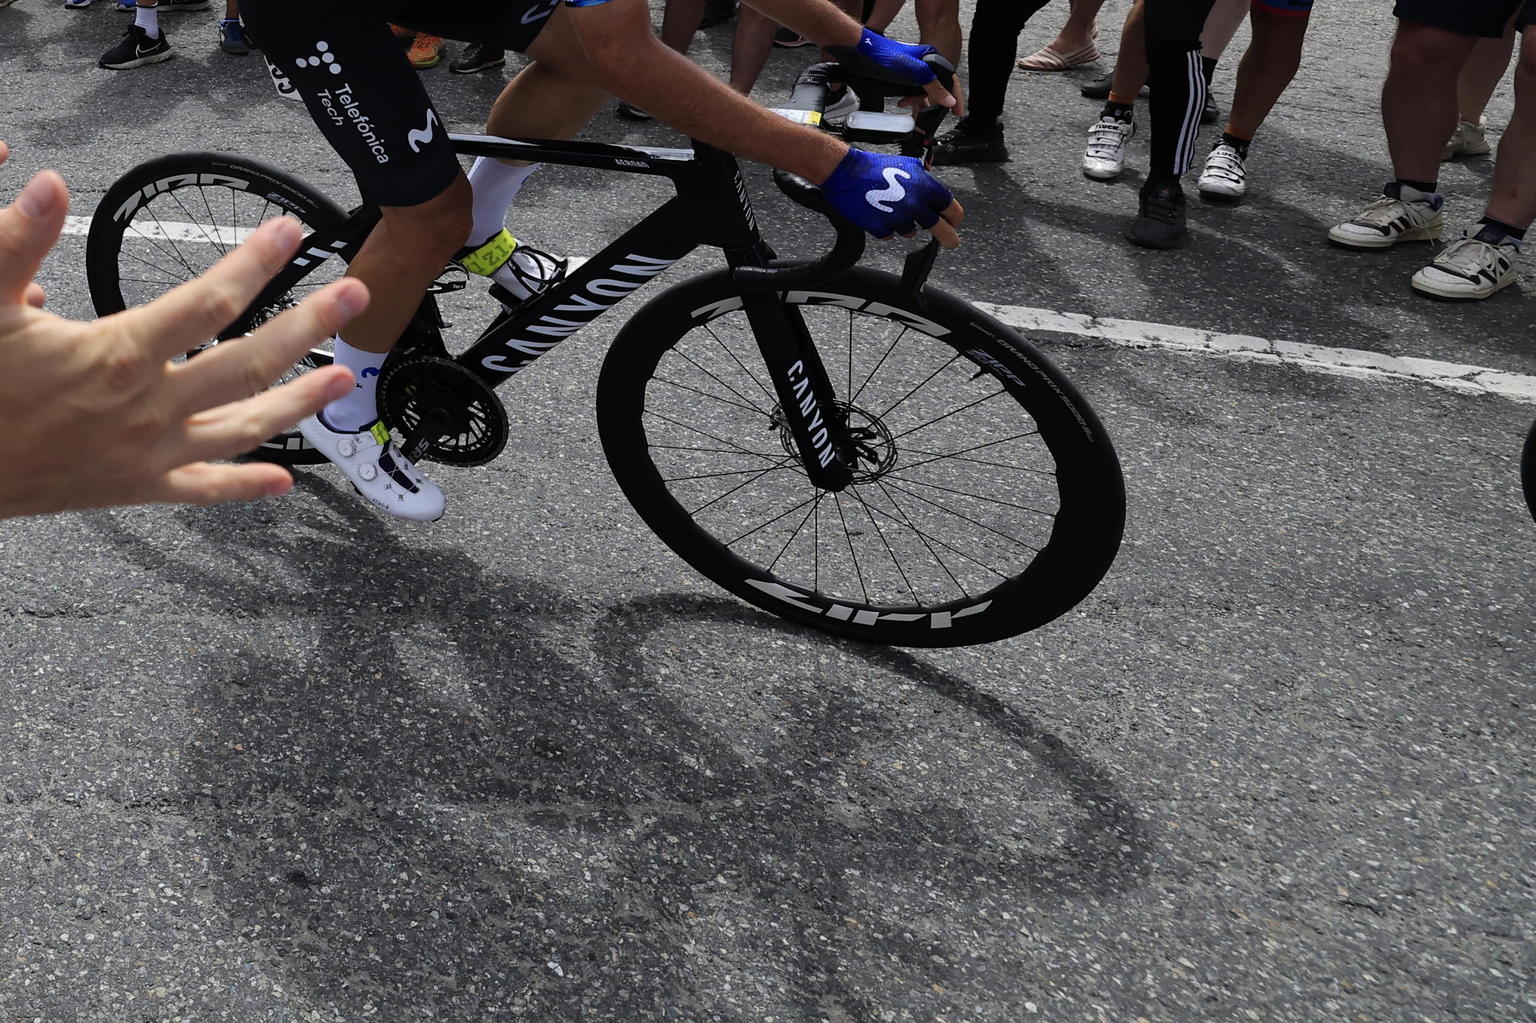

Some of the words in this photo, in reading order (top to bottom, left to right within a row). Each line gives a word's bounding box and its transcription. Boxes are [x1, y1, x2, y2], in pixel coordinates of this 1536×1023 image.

[317, 88, 345, 127] Tech
[335, 83, 389, 164] Telefónica
[481, 253, 680, 373] CANYON
[786, 359, 836, 469] CANYON
